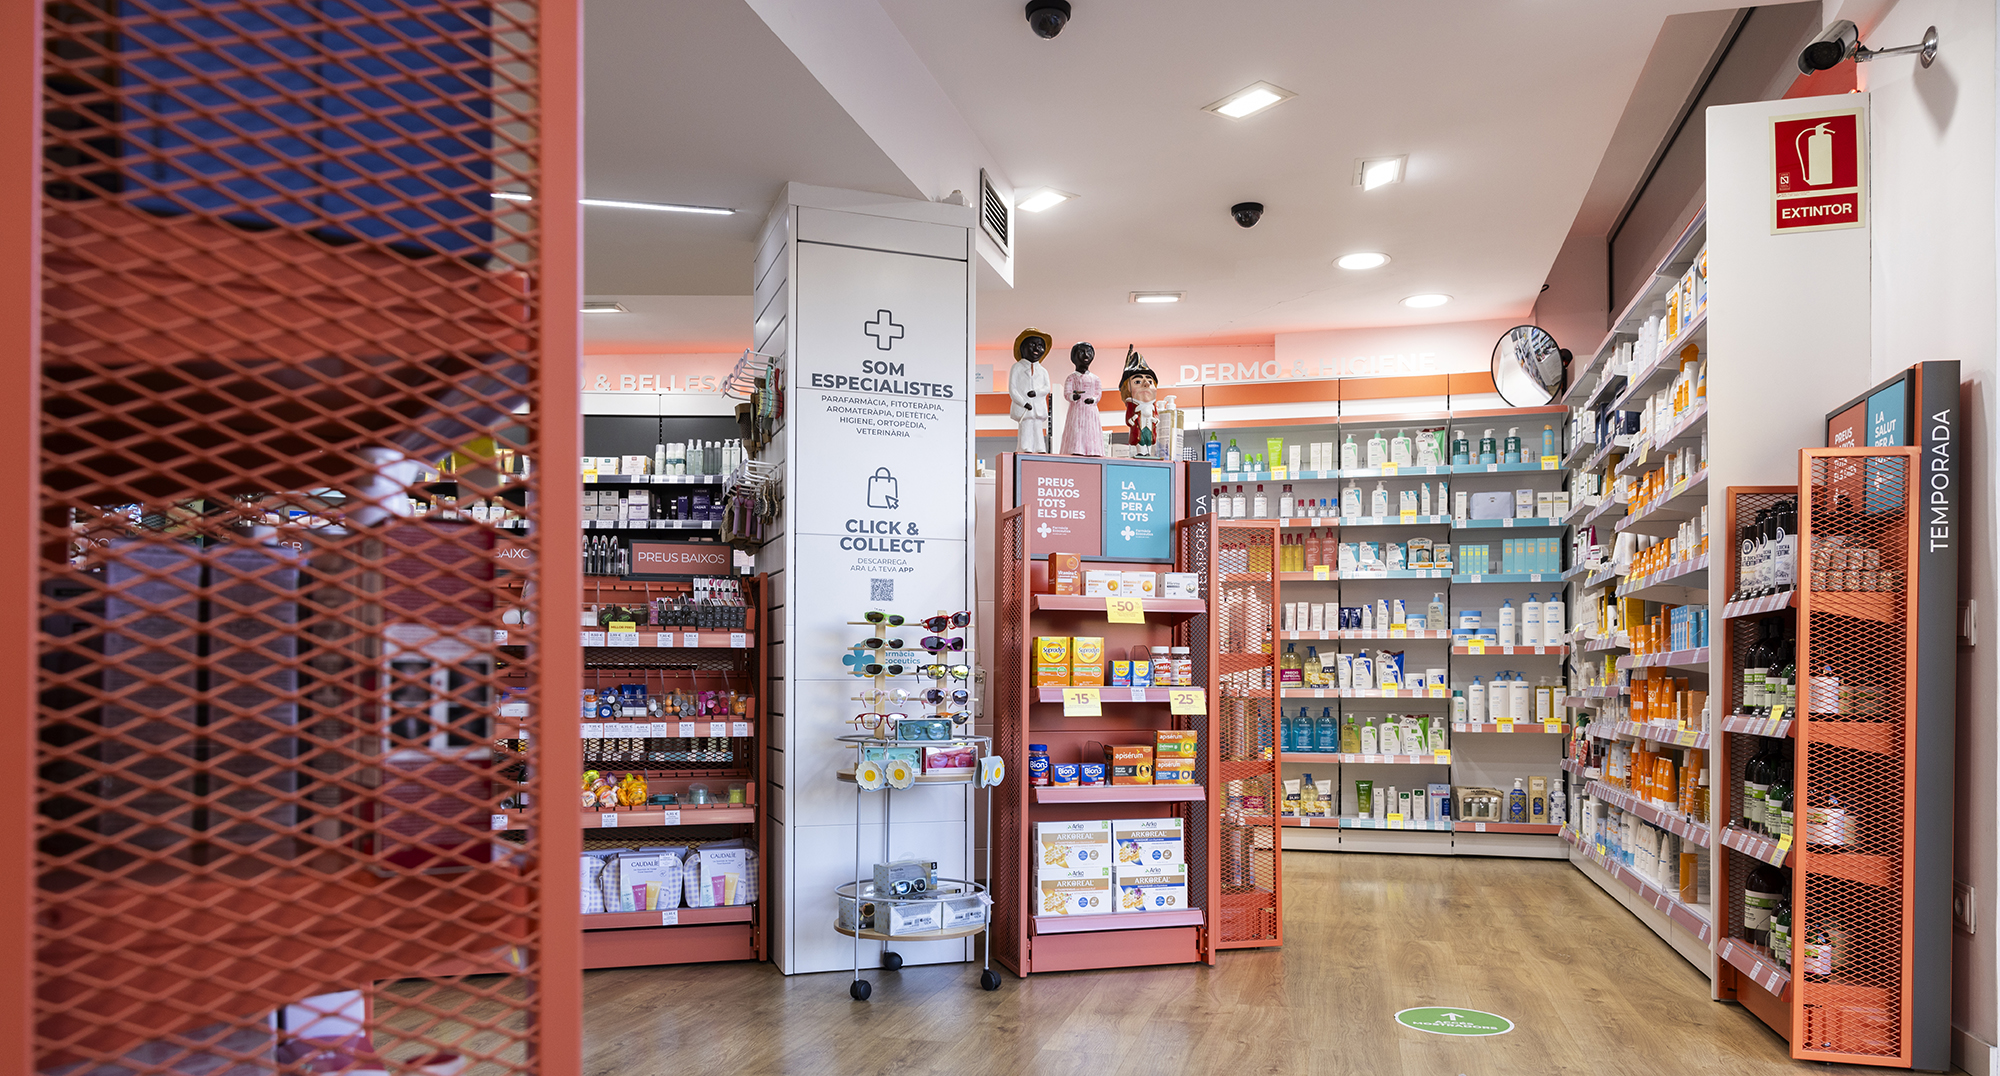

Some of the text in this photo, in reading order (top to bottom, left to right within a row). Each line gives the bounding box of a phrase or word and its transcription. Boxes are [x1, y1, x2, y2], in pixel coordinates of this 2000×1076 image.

[1782, 203, 1852, 219] EXTINTOR
[862, 360, 904, 376] SOM
[1180, 352, 1436, 383] DERMO & HIGIENE
[594, 374, 611, 391] &
[811, 373, 953, 398] ESPECIALISTES
[821, 394, 944, 412] PARAFARMÀCIA, FITOTERÀPIA,
[826, 406, 939, 421] AROMATERÀPIA, DIETÈTICA,
[1876, 410, 1884, 424] LA
[840, 416, 926, 430] HIGIENE, ORTOPÈDIA,
[1875, 419, 1896, 438] SALUT
[856, 427, 910, 438] VETERINÀRIA
[1835, 427, 1852, 444] PREUS
[1038, 477, 1074, 488] PREUS
[1122, 481, 1135, 490] LA
[1930, 409, 1950, 552] TEMPORADA
[1038, 488, 1080, 498] BAIXOS
[1121, 491, 1156, 501] SALUT
[1037, 498, 1066, 508] TOTS
[1121, 502, 1153, 512] PER A
[1037, 509, 1086, 519] ELS DIES
[1121, 512, 1149, 522] TOTS
[845, 519, 919, 536] CLICK &
[839, 536, 925, 553] COLLECT
[1196, 495, 1207, 590] EMPORADA
[638, 552, 725, 564] PREUS BAIXOS
[857, 557, 907, 566] DESCARREGA
[1174, 694, 1194, 704] -25
[1115, 752, 1143, 760] apisérum
